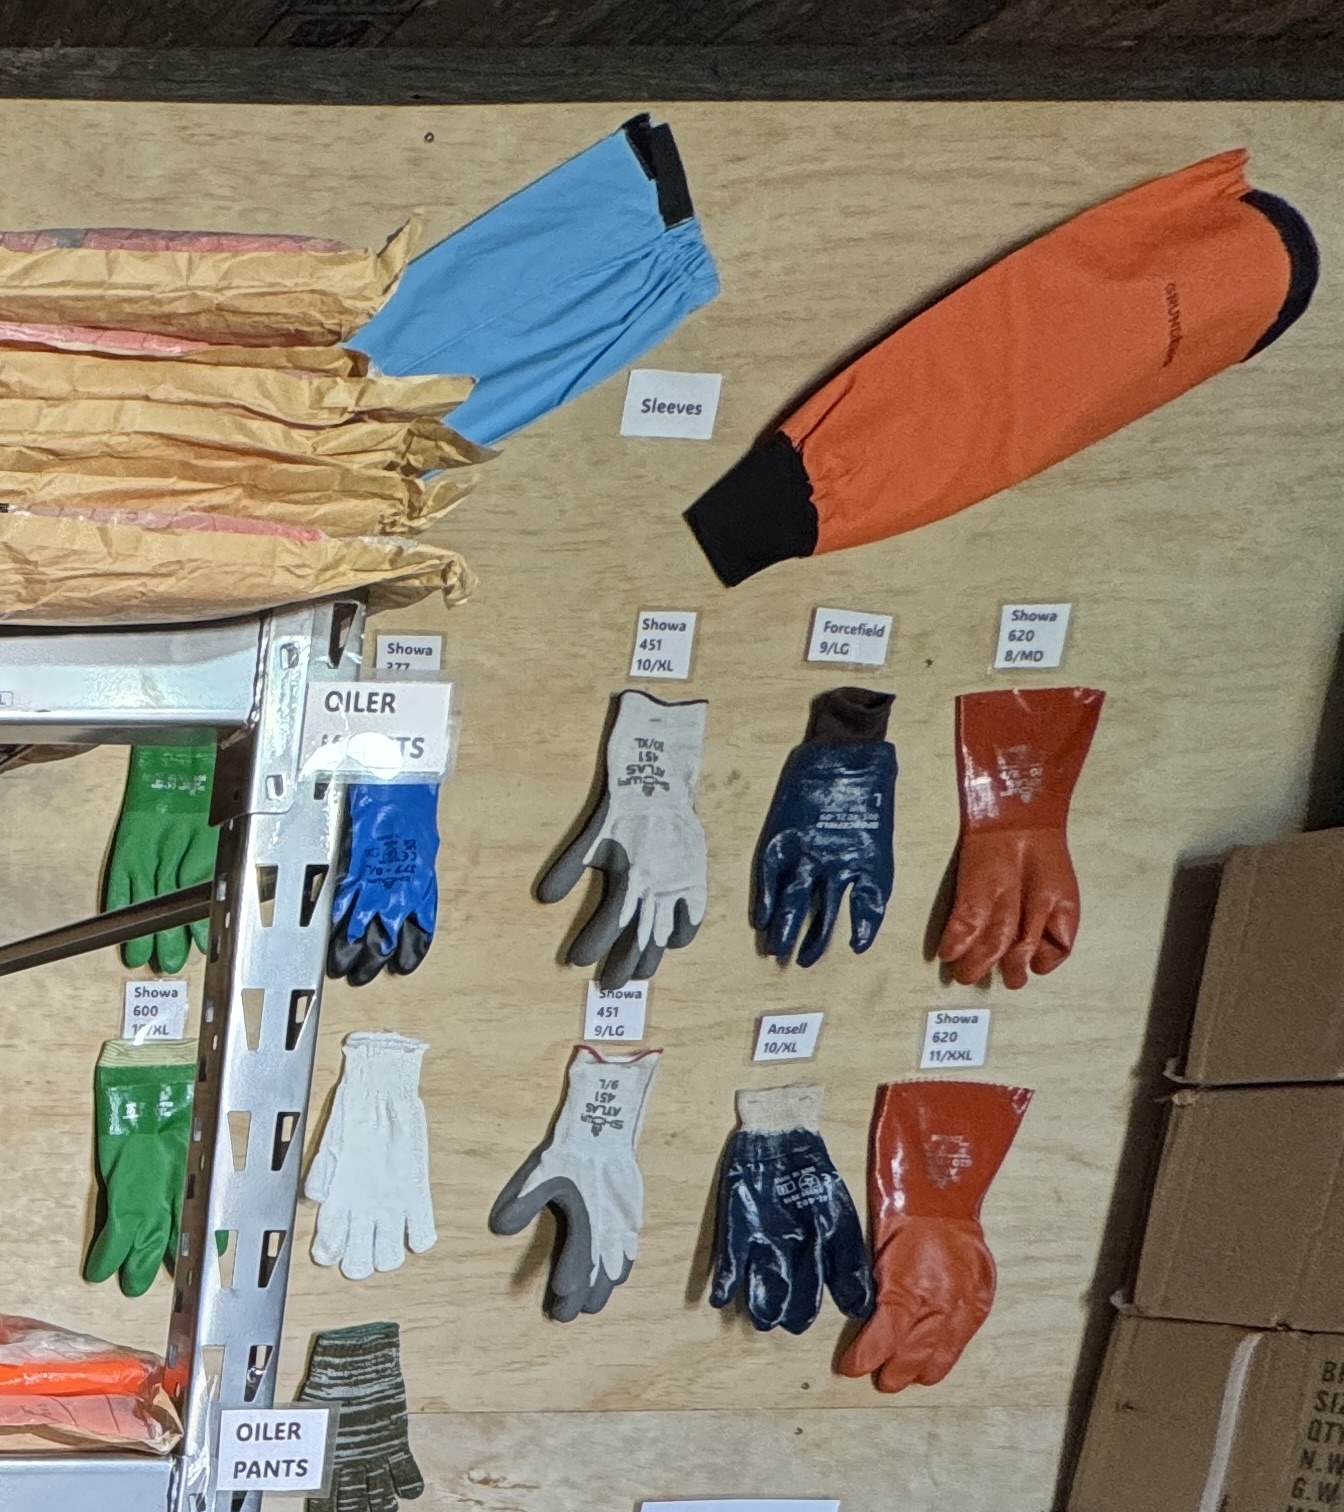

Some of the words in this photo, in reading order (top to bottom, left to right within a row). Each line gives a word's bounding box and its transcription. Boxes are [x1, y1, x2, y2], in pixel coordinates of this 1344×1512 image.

[640, 397, 703, 417] Sleeves
[1011, 609, 1058, 622] Showa
[641, 618, 687, 633] Showa
[823, 620, 885, 638] Forcefield
[1008, 629, 1035, 643] 620
[387, 642, 433, 658] Showa
[639, 639, 662, 651] 451
[820, 642, 850, 656] 9/LG
[1004, 650, 1044, 662] 8/MD
[636, 659, 674, 673] 10/XL
[324, 690, 397, 714] OILER
[134, 986, 179, 998] Showa
[132, 1005, 159, 1017] 600
[596, 1006, 619, 1018] 451
[934, 1013, 980, 1025] Showa
[593, 1025, 625, 1037] 9/LG
[767, 1022, 809, 1035] Ansell
[932, 1032, 958, 1043] 620
[763, 1042, 798, 1053] 10/XL
[928, 1050, 973, 1062] 11/XXL
[236, 1421, 301, 1441] OILER
[232, 1459, 309, 1480] PANTS
